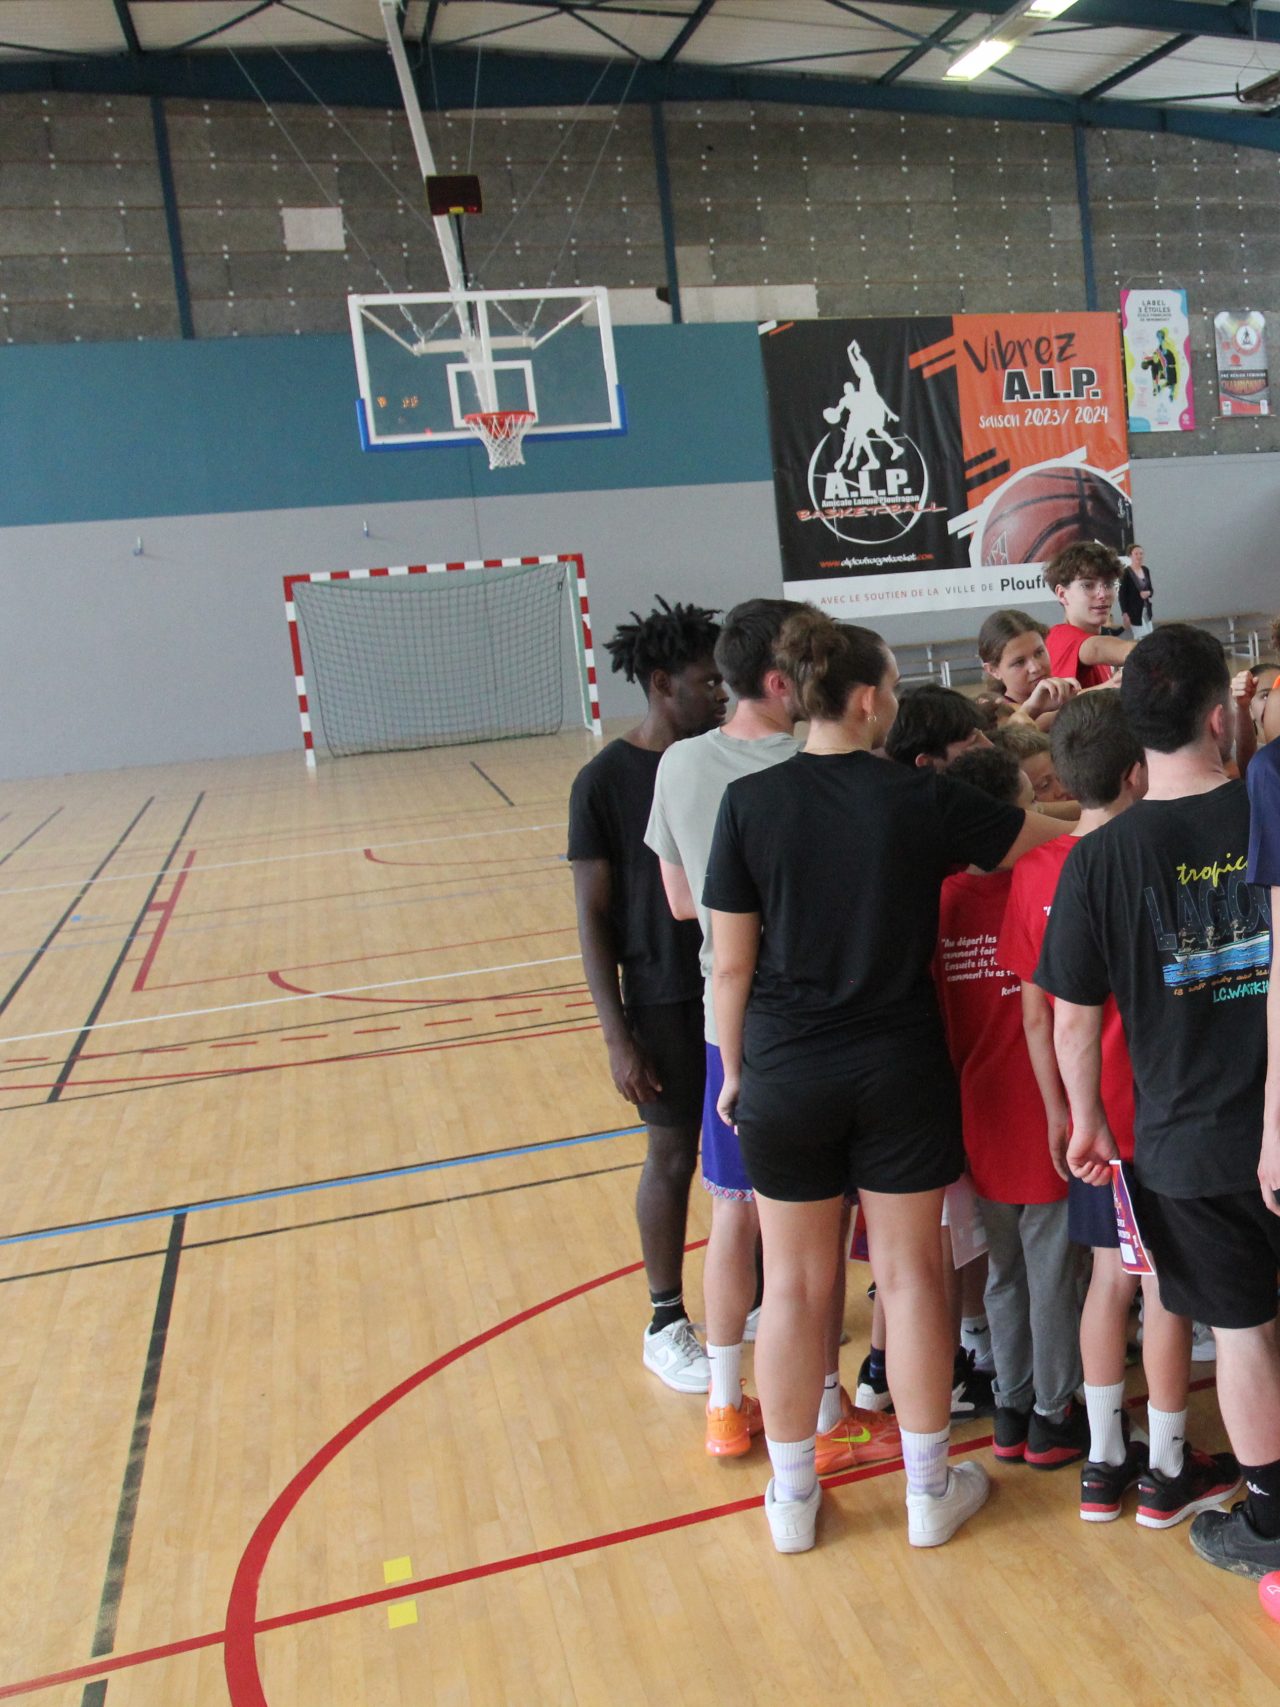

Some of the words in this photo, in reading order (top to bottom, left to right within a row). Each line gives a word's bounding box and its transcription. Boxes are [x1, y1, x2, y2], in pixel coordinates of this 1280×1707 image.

[963, 329, 1078, 373] Vibrez
[1002, 367, 1102, 403] A.L.P.
[978, 413, 1020, 429] saison
[1075, 406, 1109, 425] 2024
[824, 468, 913, 500] A.L.P.
[820, 595, 845, 604] AVEC
[850, 594, 861, 602] LE
[864, 591, 907, 601] SOUTIEN
[911, 589, 924, 597] DE
[927, 588, 939, 596] LA
[945, 584, 976, 594] VILLE
[981, 582, 993, 591] DE
[984, 934, 997, 944] les
[945, 959, 976, 971] Ensuite
[977, 957, 988, 968] ils
[947, 968, 982, 982] comment
[984, 968, 995, 977] tu
[995, 969, 1005, 977] as
